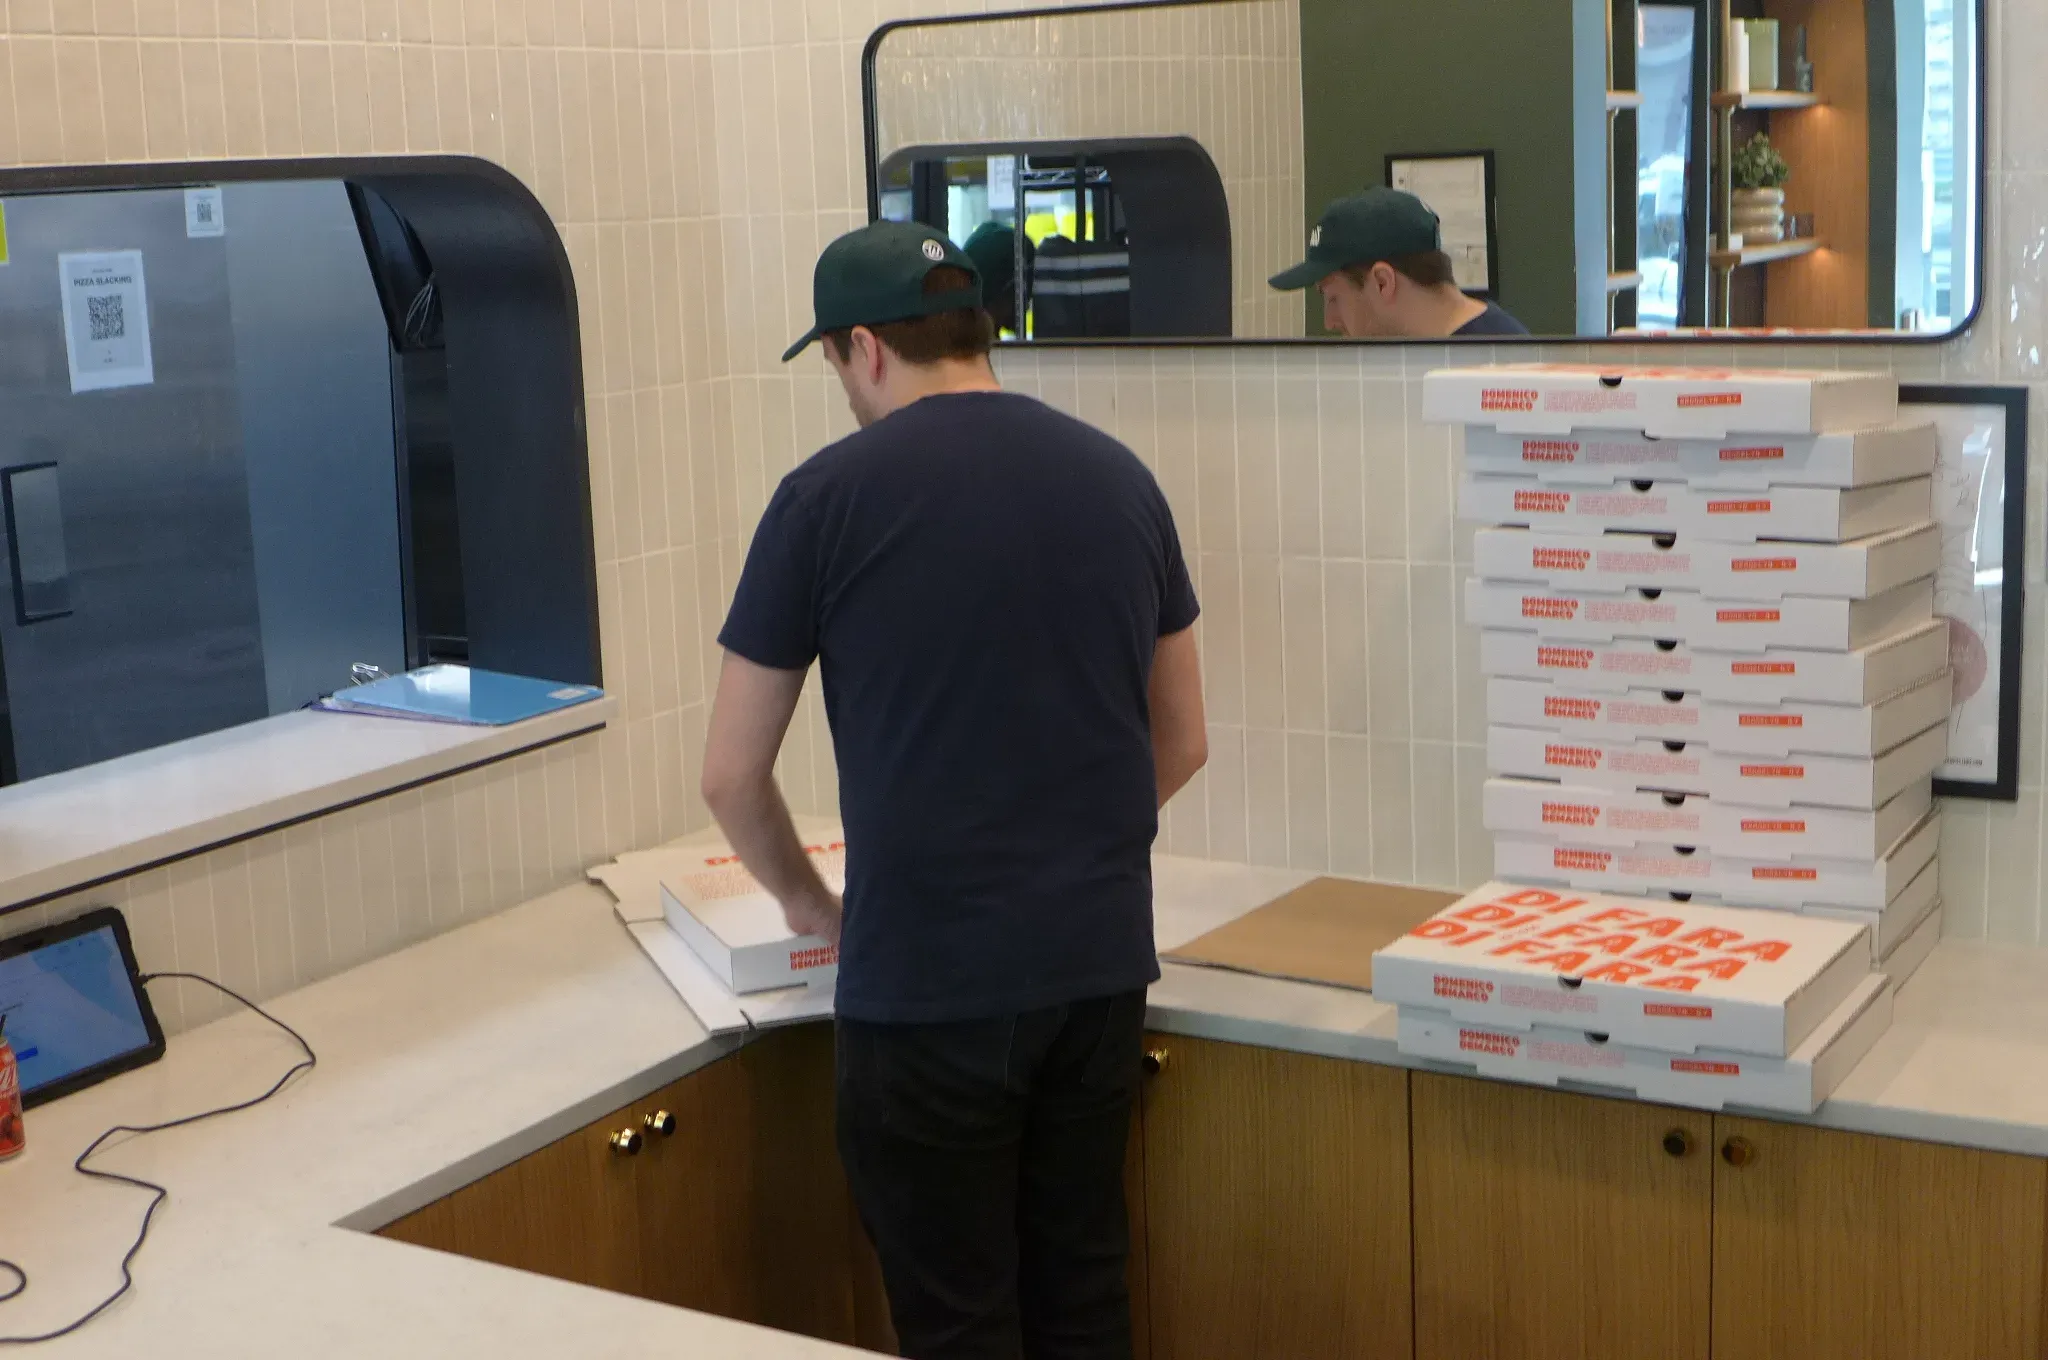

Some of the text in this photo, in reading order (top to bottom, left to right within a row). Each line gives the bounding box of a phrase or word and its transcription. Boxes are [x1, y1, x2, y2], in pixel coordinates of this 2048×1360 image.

[73, 278, 94, 287] PIZZA
[1481, 389, 1539, 401] DOMENICO
[1480, 401, 1534, 411] DEMARCO
[1522, 442, 1580, 452] DOMENICO
[1523, 452, 1574, 461] DEMARCO
[1513, 492, 1572, 503] DOMENICO
[1513, 503, 1567, 512] DEMARCO
[1532, 548, 1592, 561] DOMENICO
[1532, 559, 1586, 570] DEMARCO
[1521, 597, 1580, 610] DOMENICO
[1521, 608, 1576, 619] DEMARCO
[1536, 647, 1596, 661] DOMENICO
[1536, 657, 1590, 669] DEMARCO
[1543, 697, 1602, 711] DOMENICO
[1543, 707, 1597, 720] DEMARCO
[1544, 745, 1604, 760] DOMENICO
[1543, 756, 1599, 769] DEMARCO
[1541, 802, 1602, 817] DOMENICO
[1541, 813, 1597, 827] DEMARCO
[1552, 848, 1614, 863] DOMENICO
[1552, 859, 1610, 872] DEMARCO
[1500, 888, 1792, 962] DI FARA
[1452, 904, 1747, 980] DI FARA
[790, 945, 839, 962] DOMENIC
[1408, 920, 1701, 993] DI FARA
[1433, 976, 1495, 992] DOMENICO
[1433, 986, 1488, 1002] DEMARCO
[1459, 1031, 1520, 1047] DOMENICO
[1459, 1039, 1516, 1056] DEMARCO
